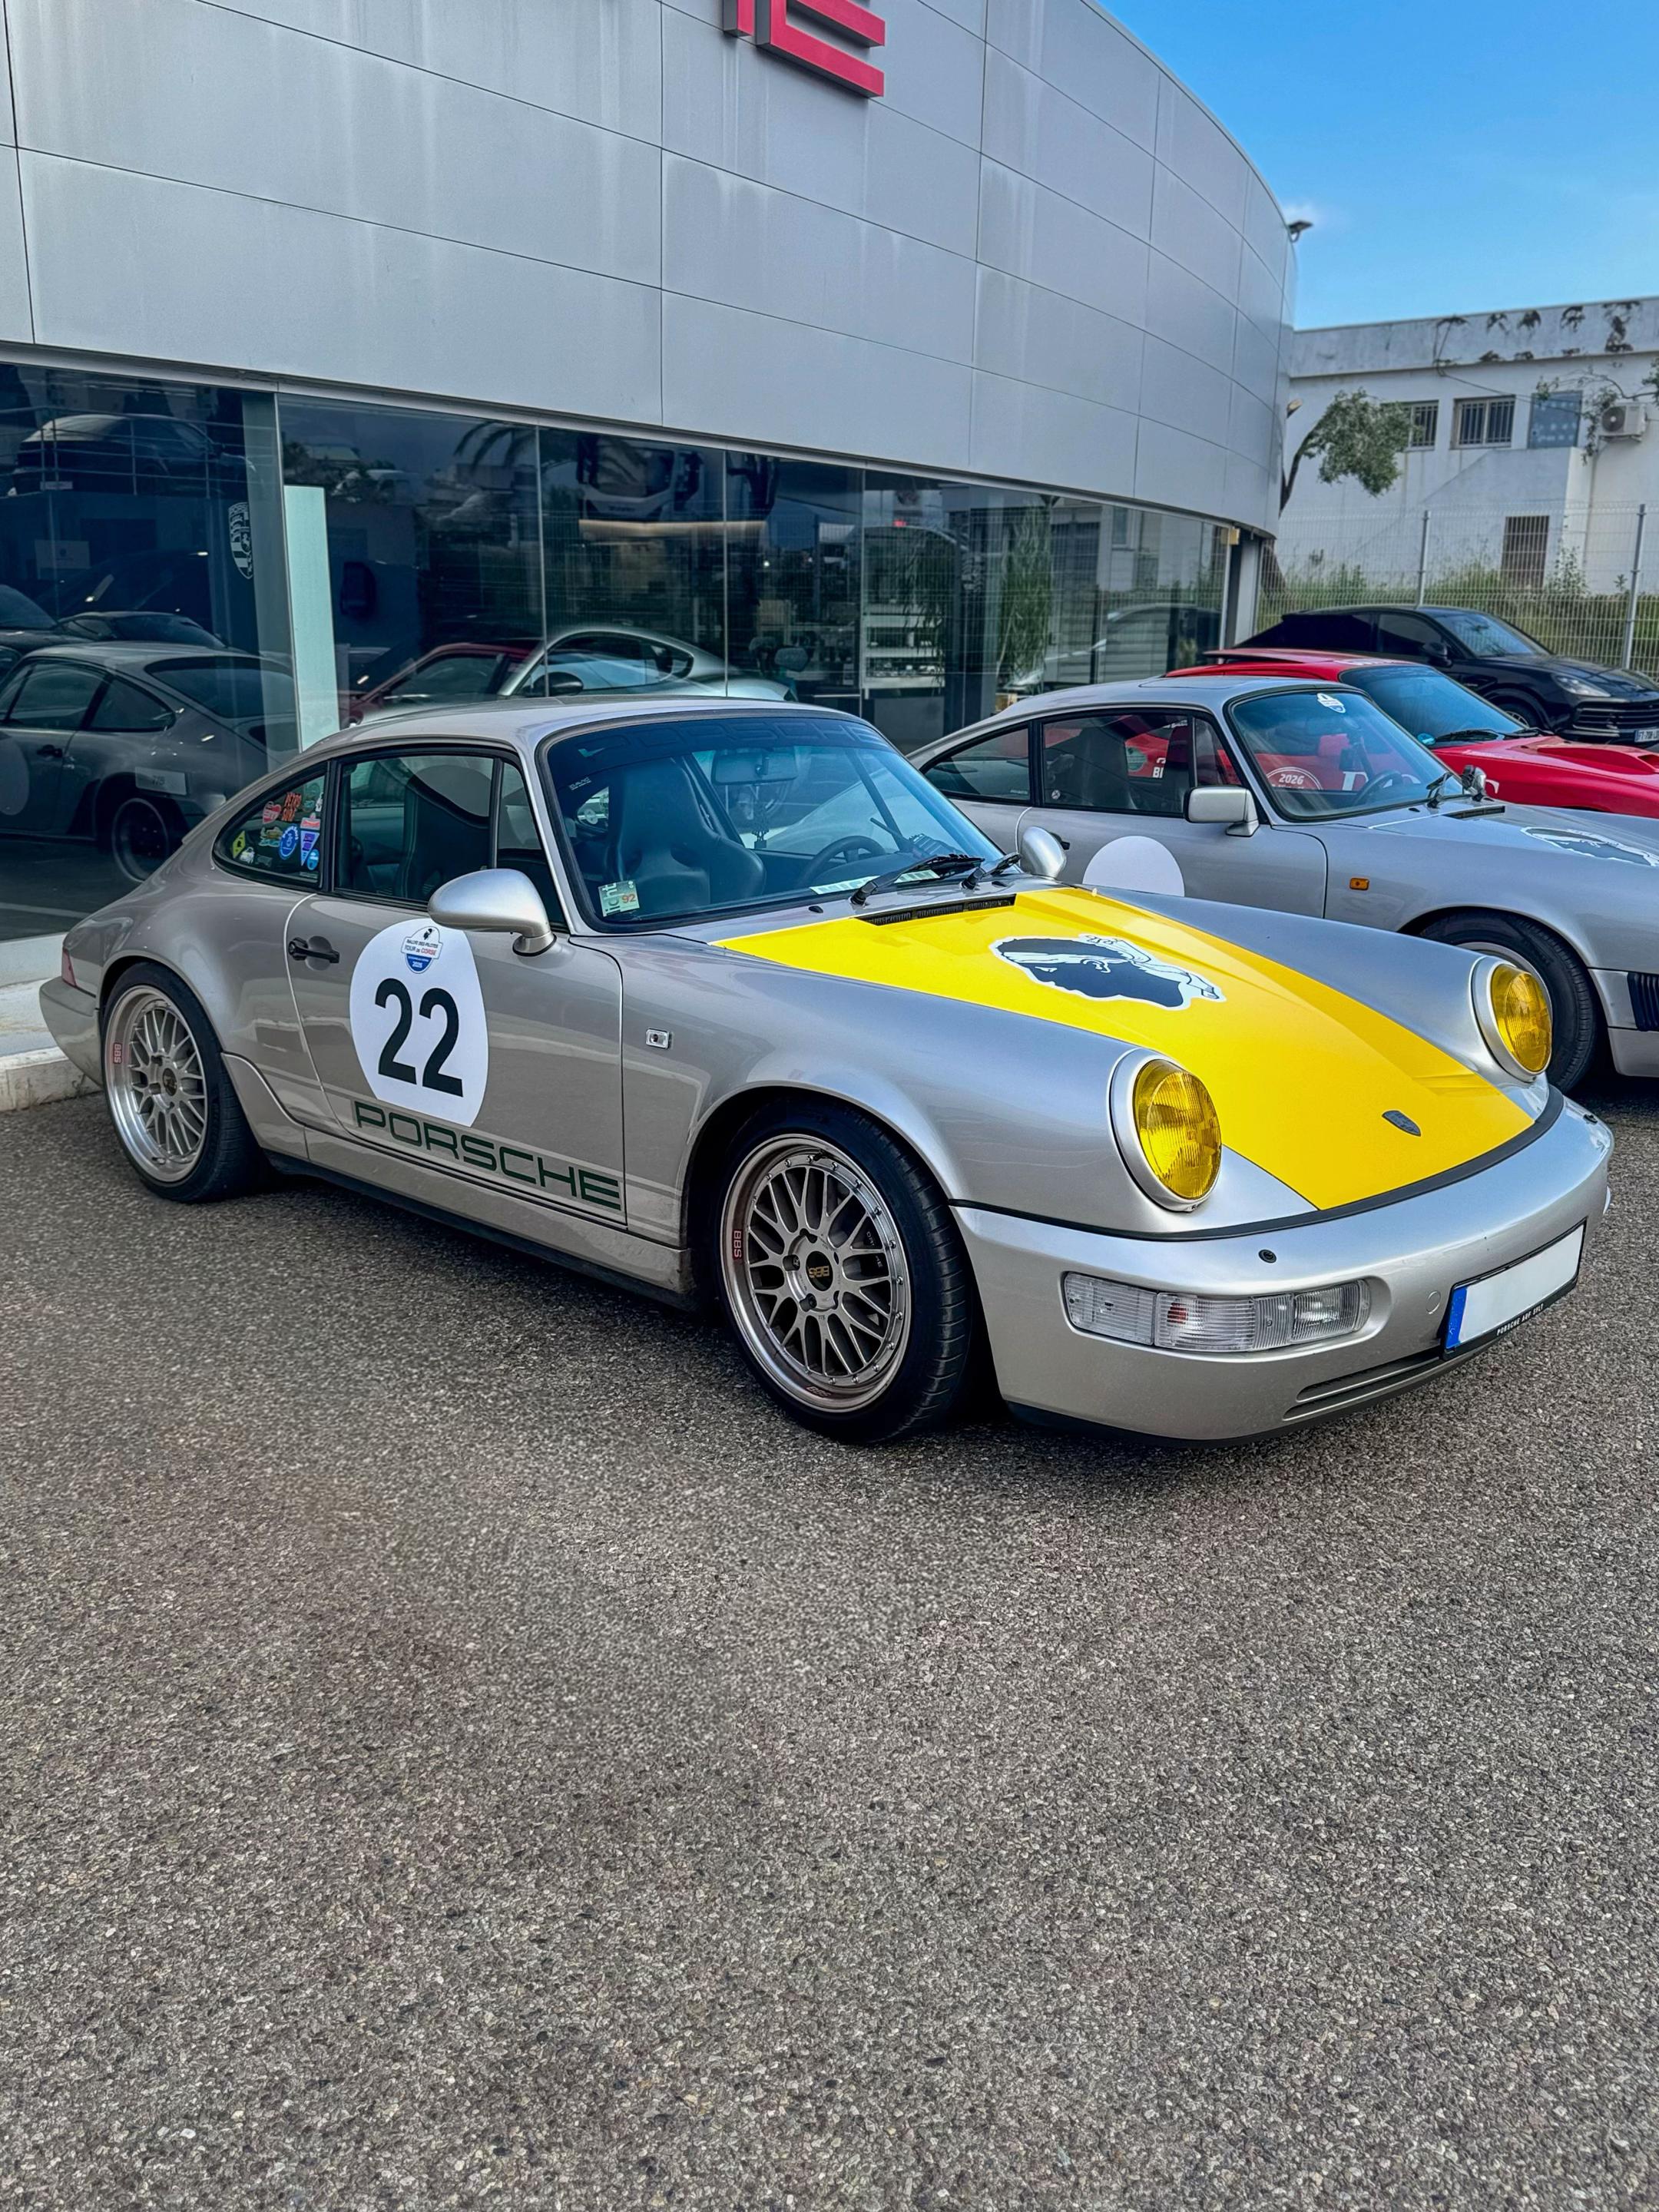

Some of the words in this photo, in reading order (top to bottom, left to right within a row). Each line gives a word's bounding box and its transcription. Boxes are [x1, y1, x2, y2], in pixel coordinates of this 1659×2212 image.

[1279, 773, 1305, 785] 2026
[375, 978, 463, 1098] 22
[354, 1101, 621, 1210] PORSCHE
[733, 1230, 742, 1258] BBS
[1497, 1318, 1520, 1336] PORSCHE
